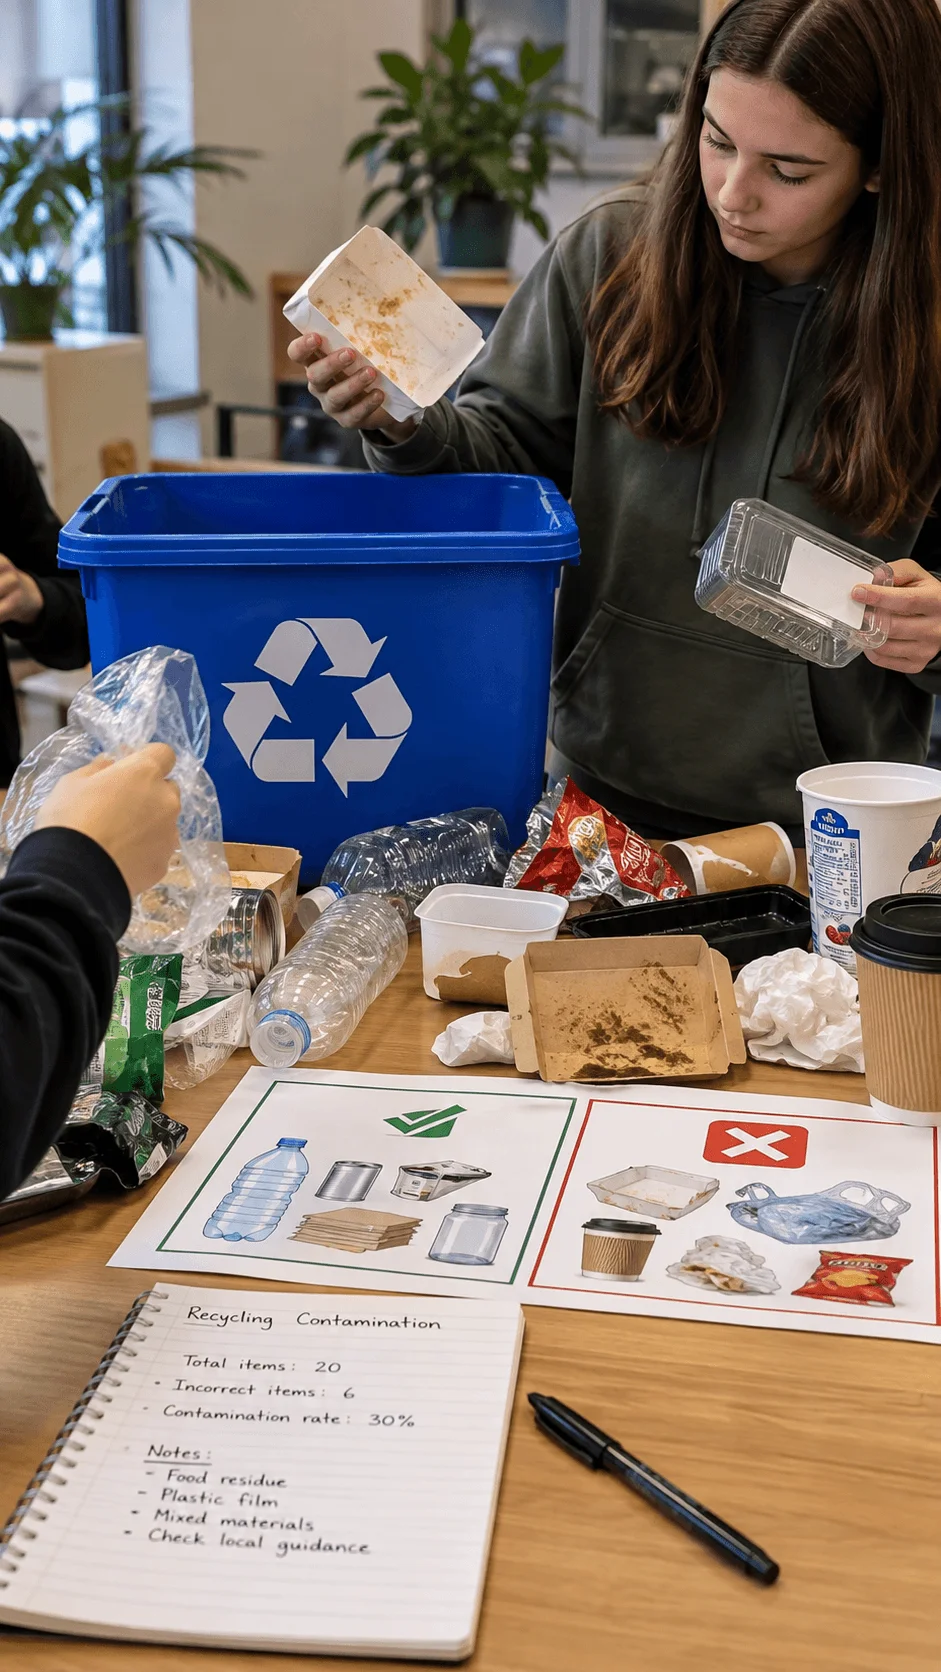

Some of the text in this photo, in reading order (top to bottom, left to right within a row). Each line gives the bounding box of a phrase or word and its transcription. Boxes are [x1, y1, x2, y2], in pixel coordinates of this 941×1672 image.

[187, 1305, 441, 1331] Recycling Contamination
[183, 1354, 227, 1369] Total
[314, 1361, 342, 1373] 20
[171, 1378, 256, 1396] Incorrect
[343, 1386, 355, 1400] 6
[162, 1404, 291, 1423] Contamination
[368, 1413, 415, 1428] 30%
[166, 1468, 287, 1489] Food residue
[160, 1487, 279, 1508] Plastic film
[153, 1508, 314, 1535] Mixed materials
[148, 1527, 370, 1559] Check local guidance
